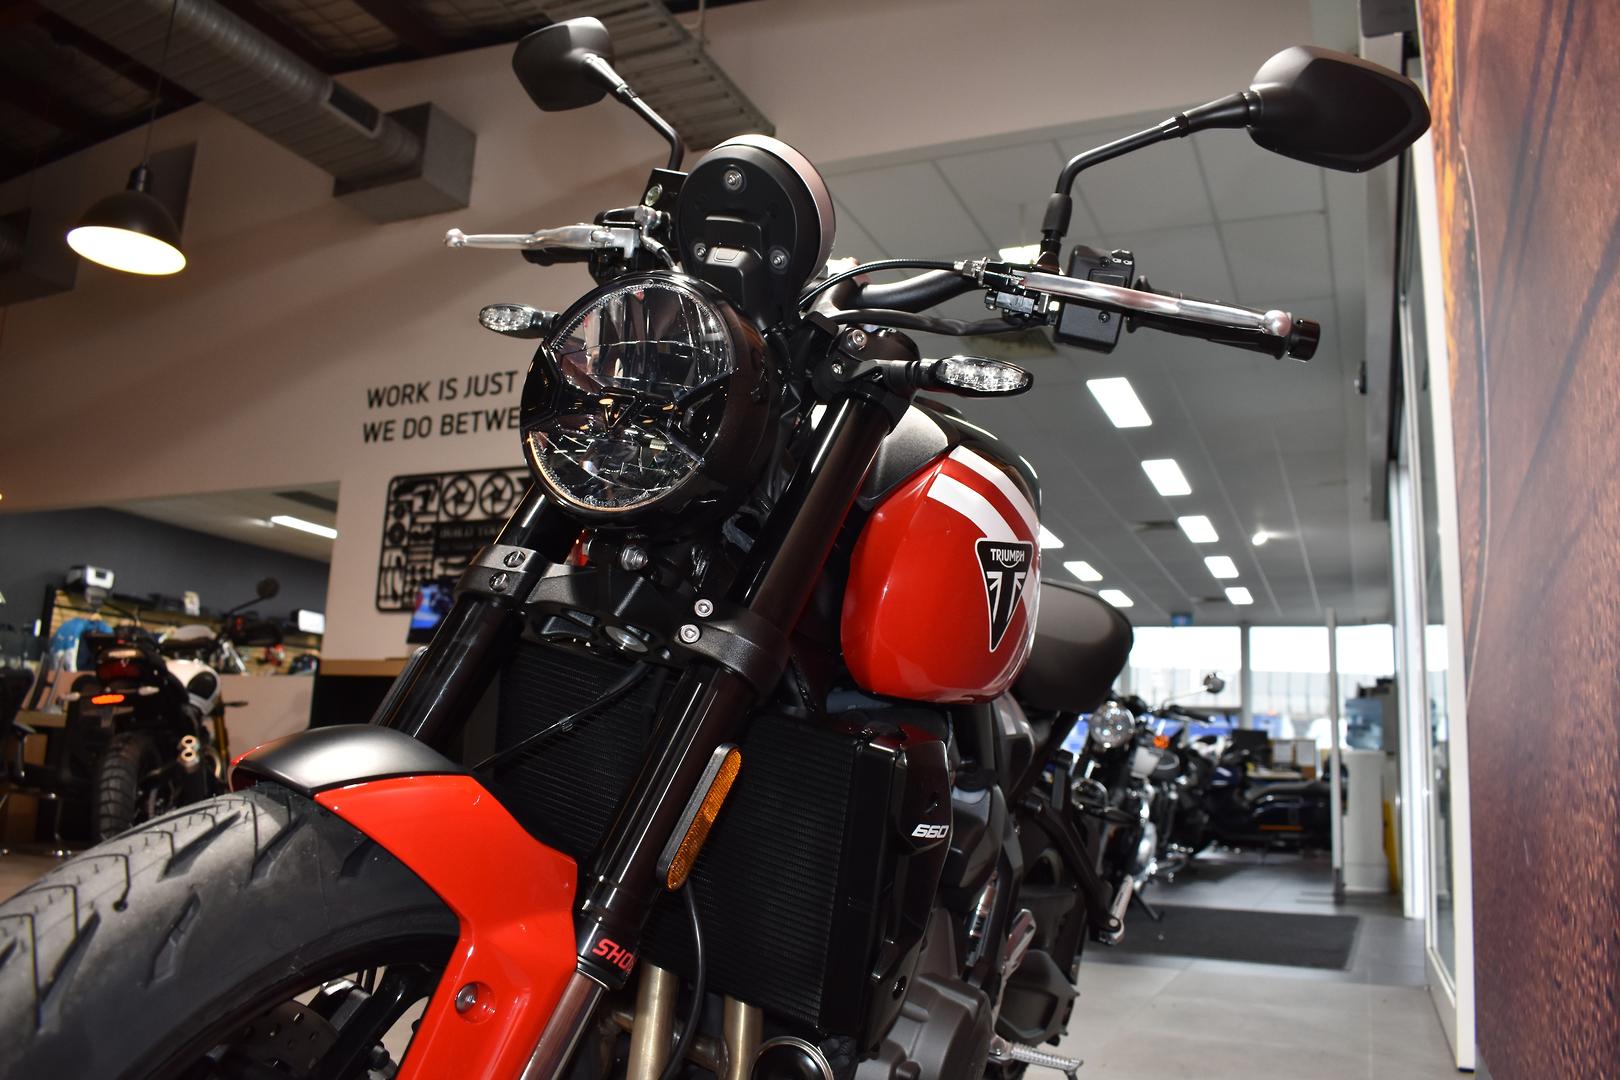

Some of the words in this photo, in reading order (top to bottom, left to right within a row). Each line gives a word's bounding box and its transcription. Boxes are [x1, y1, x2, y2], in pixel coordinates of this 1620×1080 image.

[367, 381, 431, 410] WORK
[438, 378, 458, 401] IS
[463, 370, 519, 398] JUST
[363, 419, 396, 444] WE
[402, 416, 432, 441] DO
[990, 548, 1025, 563] TRIUMPH
[911, 823, 950, 839] 660
